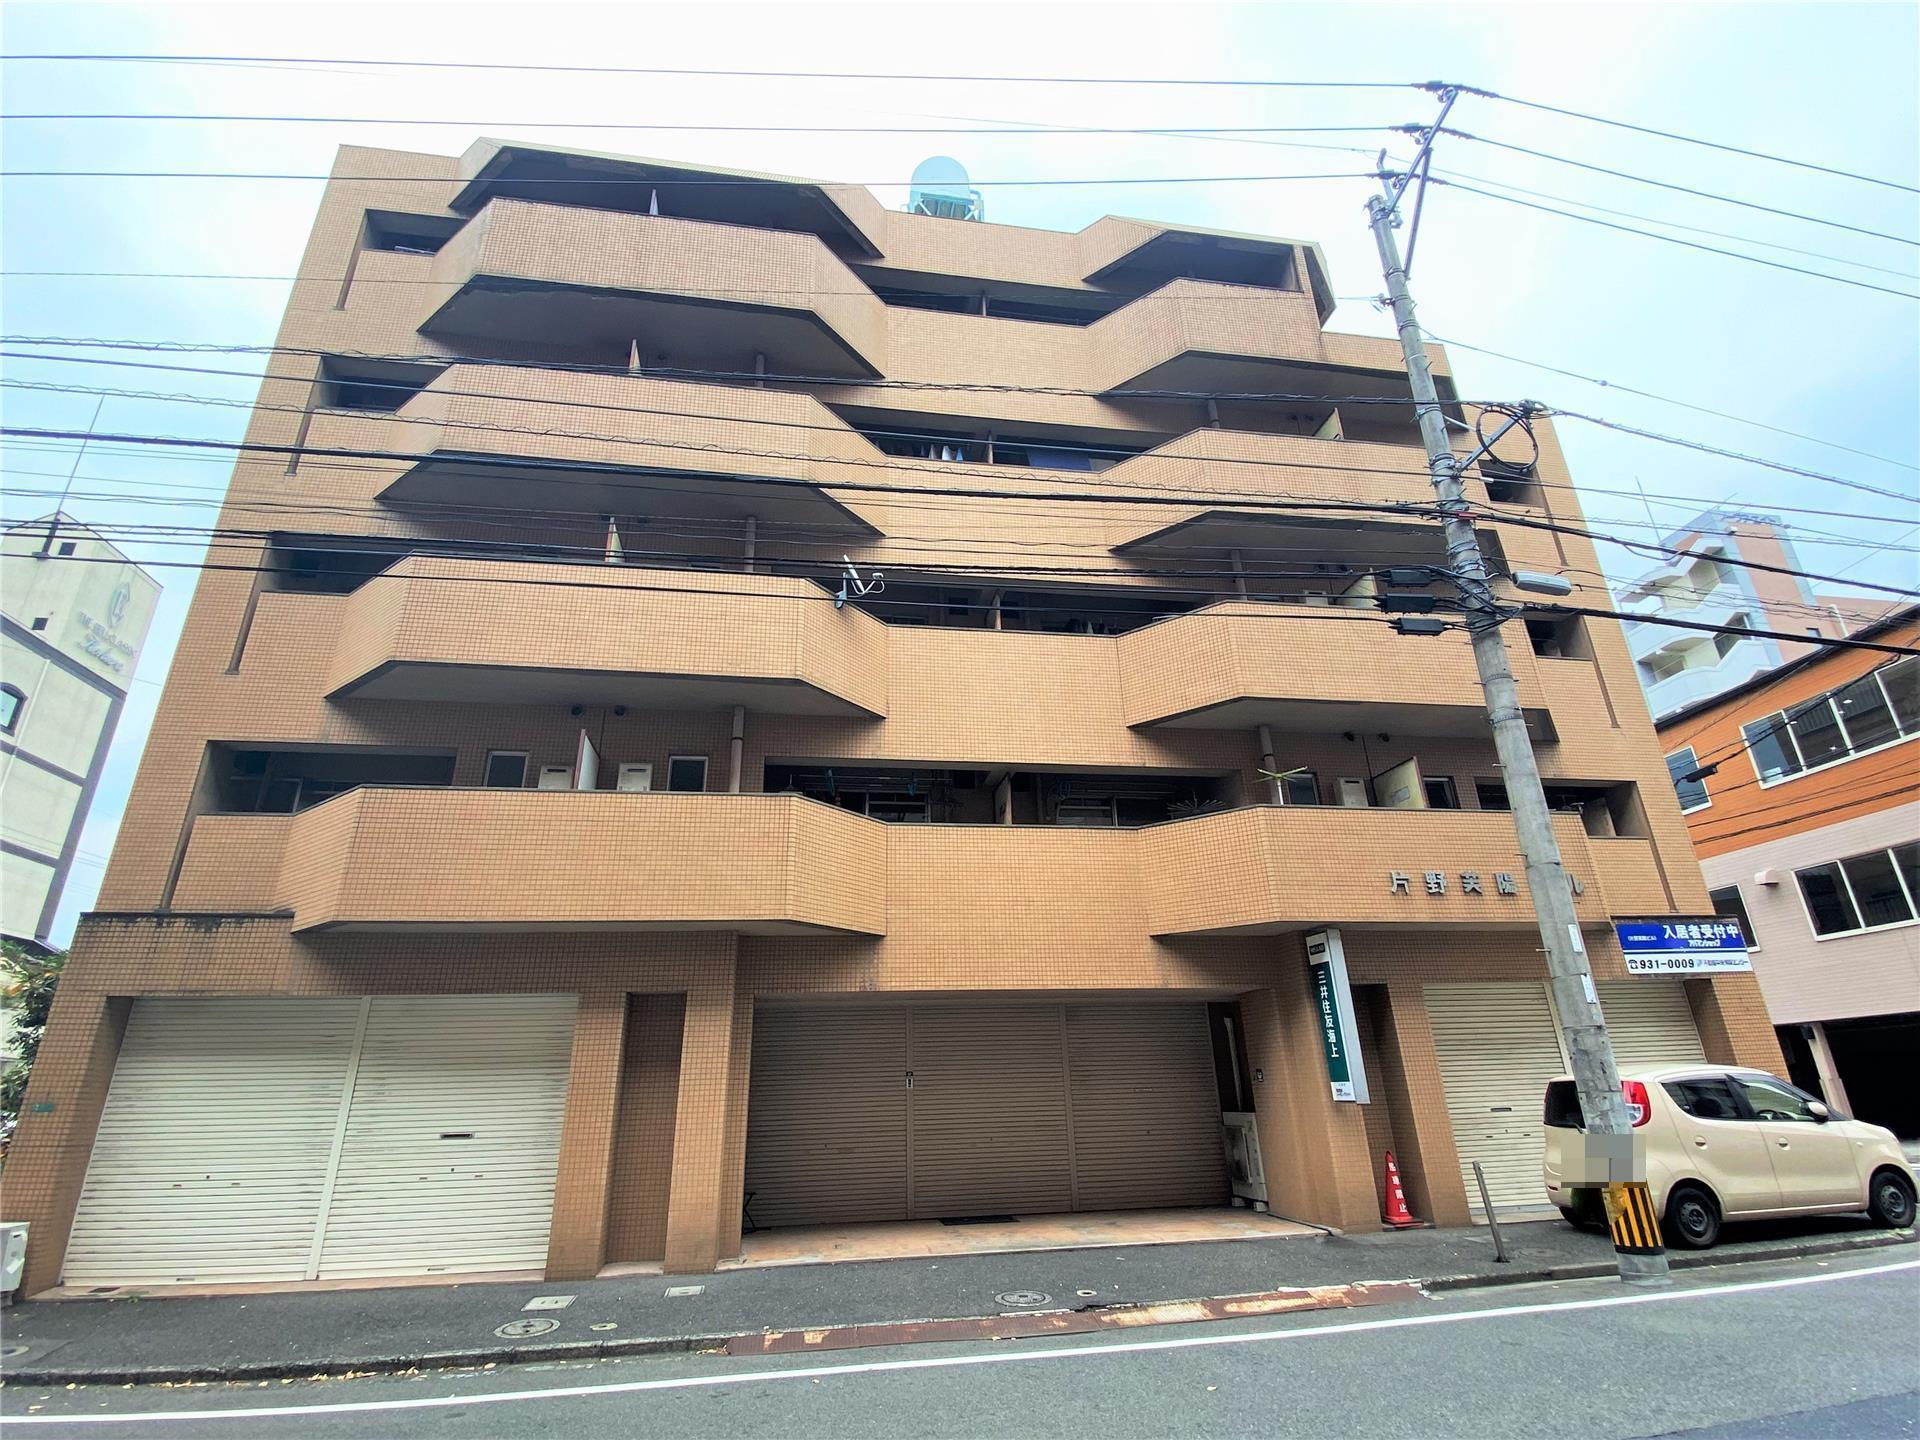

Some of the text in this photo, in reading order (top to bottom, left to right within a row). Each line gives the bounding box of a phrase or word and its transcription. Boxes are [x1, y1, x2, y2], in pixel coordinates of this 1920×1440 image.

[1390, 869, 1585, 897] 片野芙陽ル
[1663, 924, 1739, 939] 入居者受付中
[1640, 958, 1695, 970] 931-0009
[1317, 970, 1340, 1058] 三井住友海上
